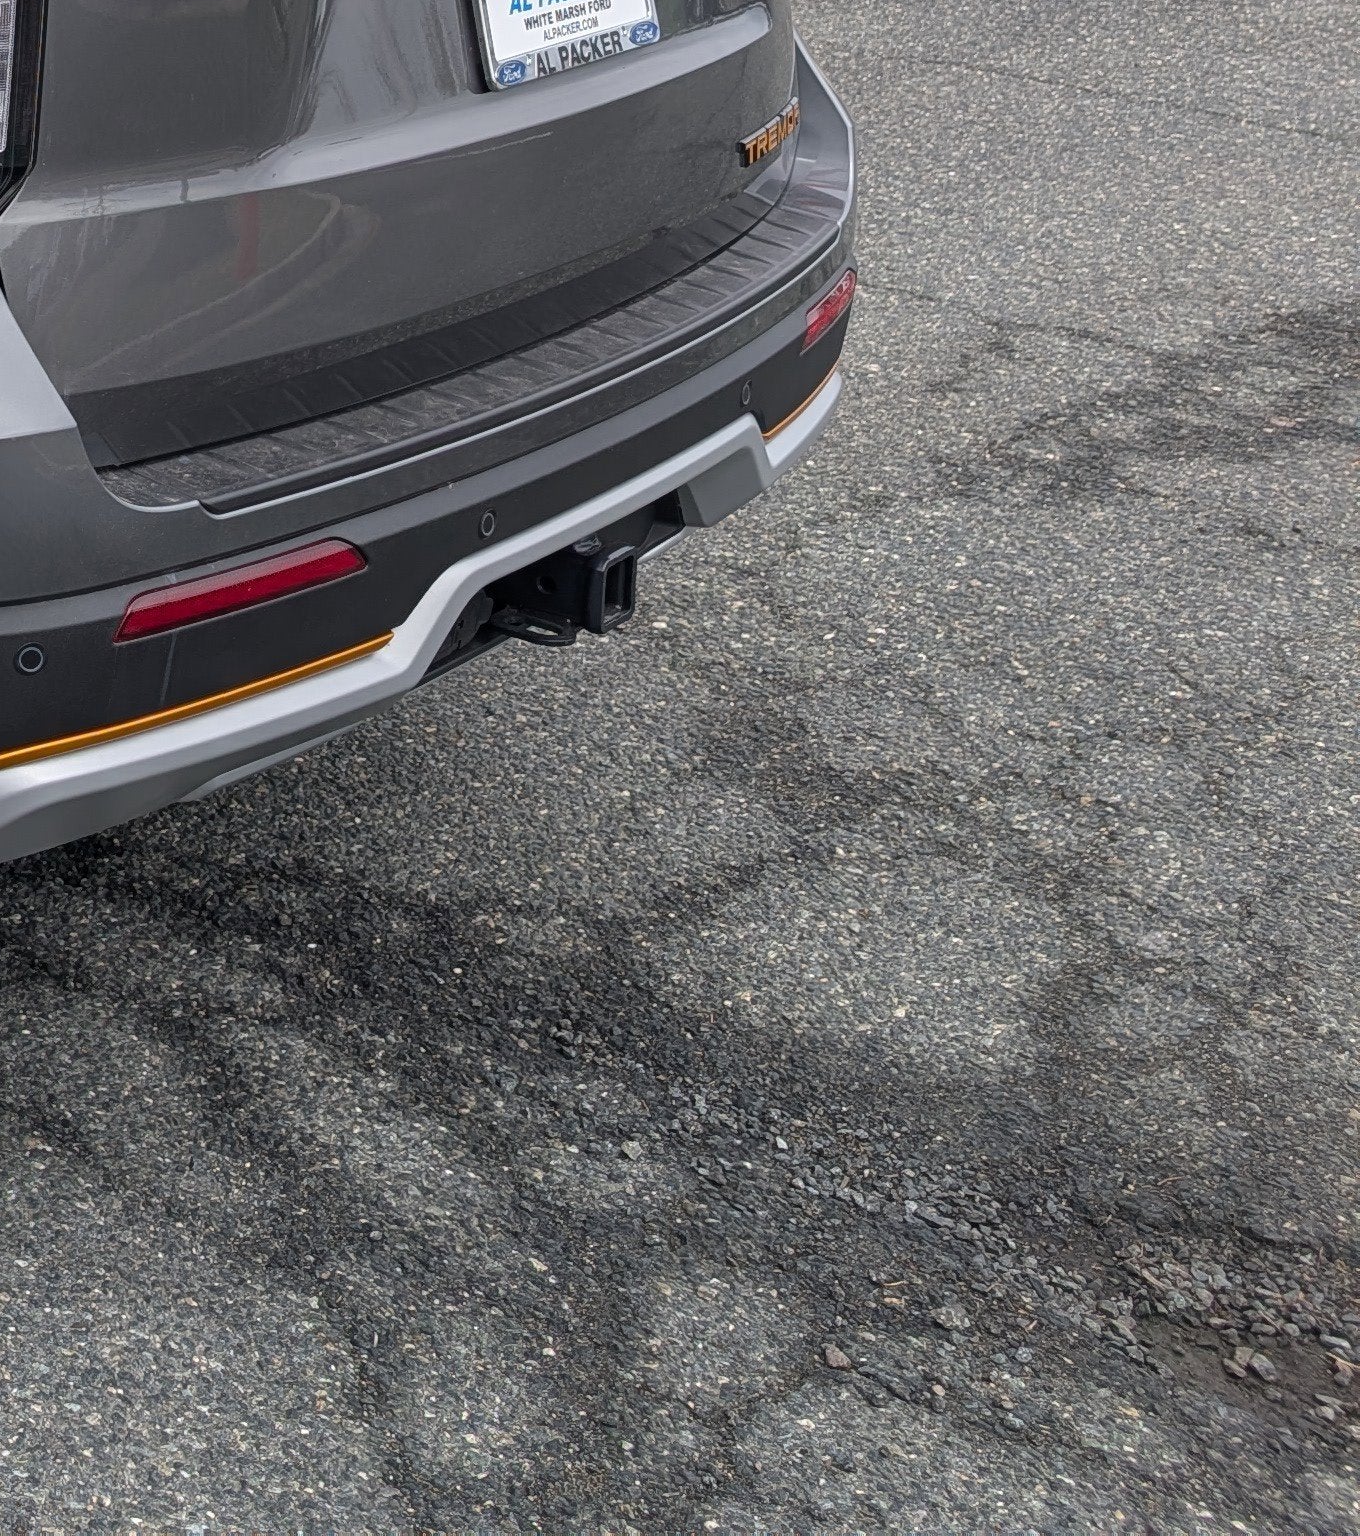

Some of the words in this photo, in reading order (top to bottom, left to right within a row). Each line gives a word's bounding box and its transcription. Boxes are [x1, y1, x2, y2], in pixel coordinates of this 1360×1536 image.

[524, 15, 554, 30] WHITE
[555, 4, 587, 22] MARSH
[543, 16, 599, 42] ALPACKER.COM
[536, 51, 557, 78] AL
[557, 30, 624, 70] PACKER
